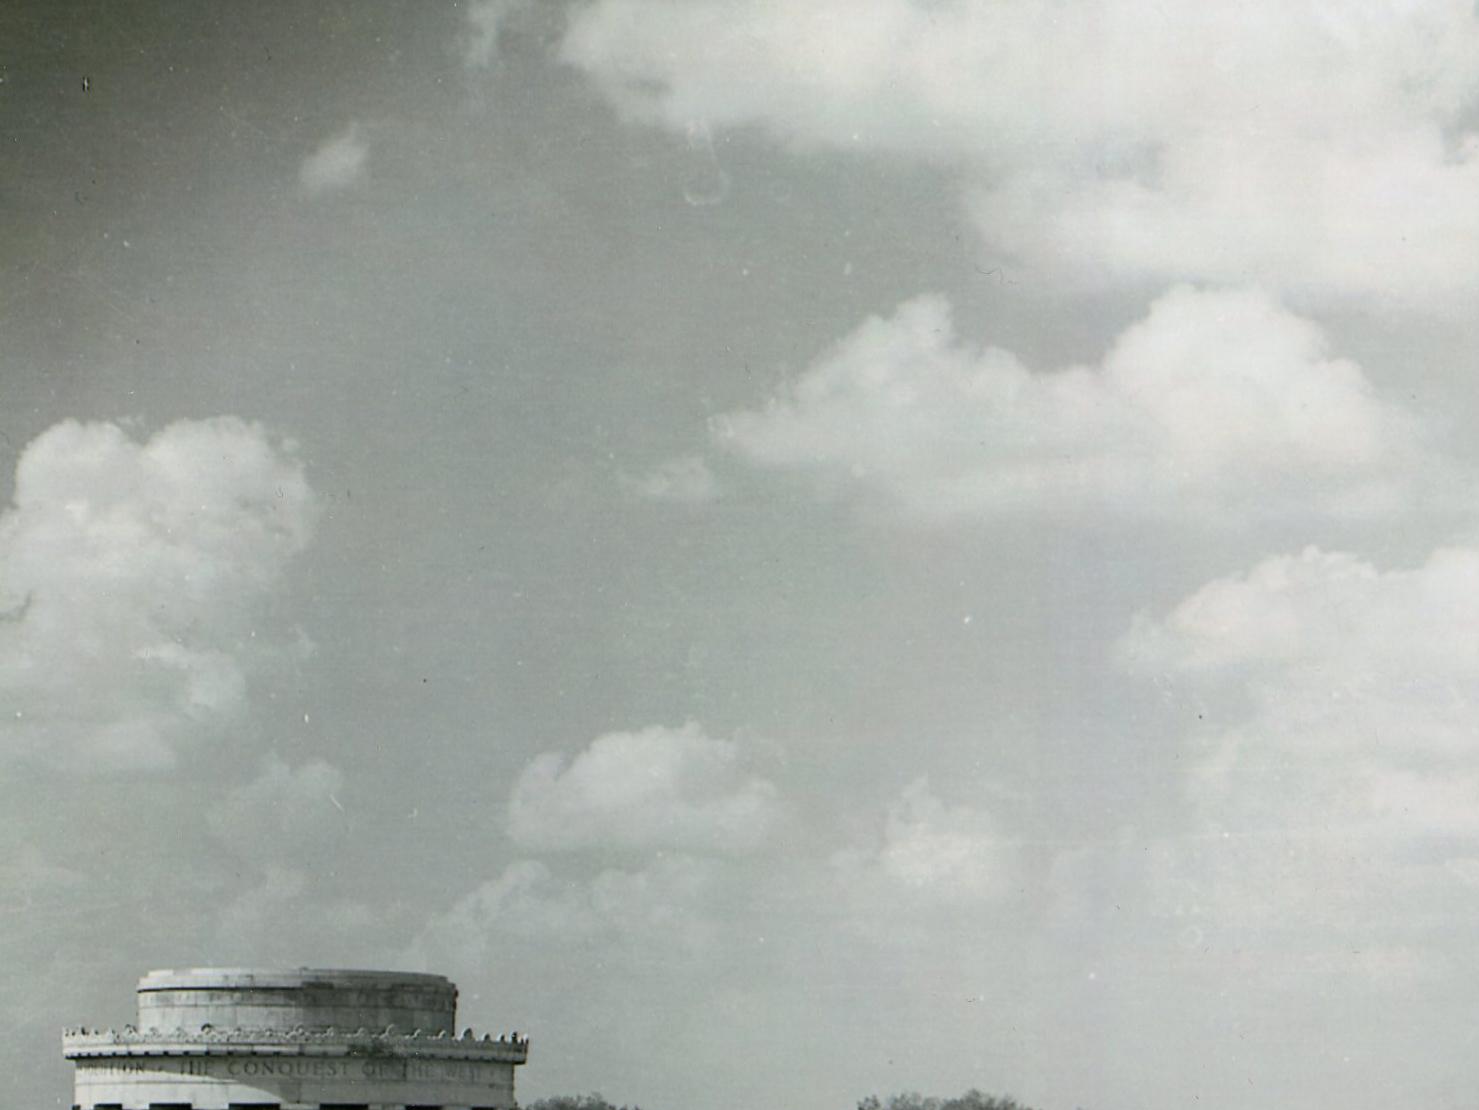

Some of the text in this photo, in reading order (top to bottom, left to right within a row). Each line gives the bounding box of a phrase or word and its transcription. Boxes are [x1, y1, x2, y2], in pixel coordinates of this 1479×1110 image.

[180, 1059, 211, 1075] THE
[227, 1059, 349, 1077] CONQUEST
[361, 1060, 386, 1077] OF
